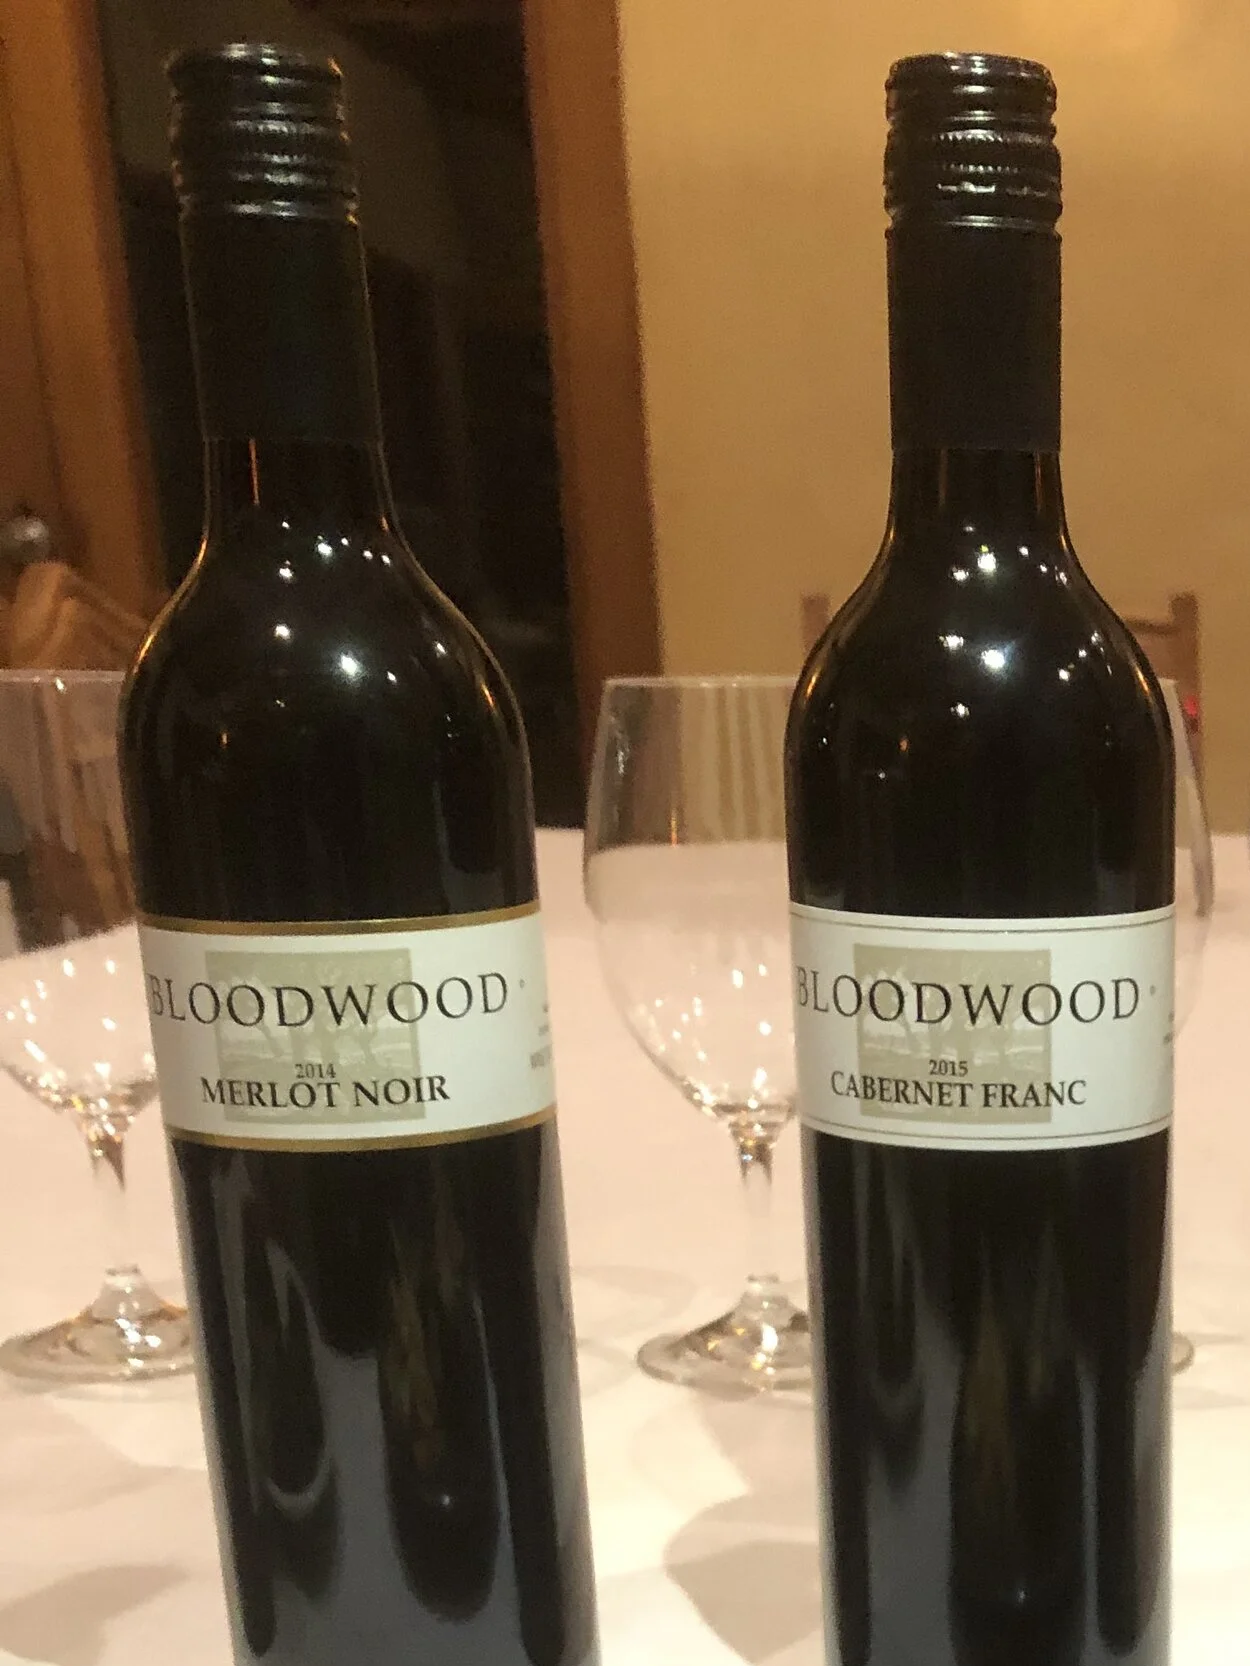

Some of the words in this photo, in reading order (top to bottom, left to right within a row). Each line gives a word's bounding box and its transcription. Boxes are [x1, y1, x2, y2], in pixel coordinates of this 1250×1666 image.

[146, 972, 508, 1028] BLOODWOOD
[796, 965, 1139, 1027] BLOODWOOD
[295, 1063, 337, 1080] 2014
[928, 1059, 969, 1077] 2015
[202, 1077, 340, 1109] MERLOT
[353, 1074, 451, 1108] NOIR
[831, 1070, 974, 1108] CABERNET
[982, 1079, 1088, 1108] FRANC
